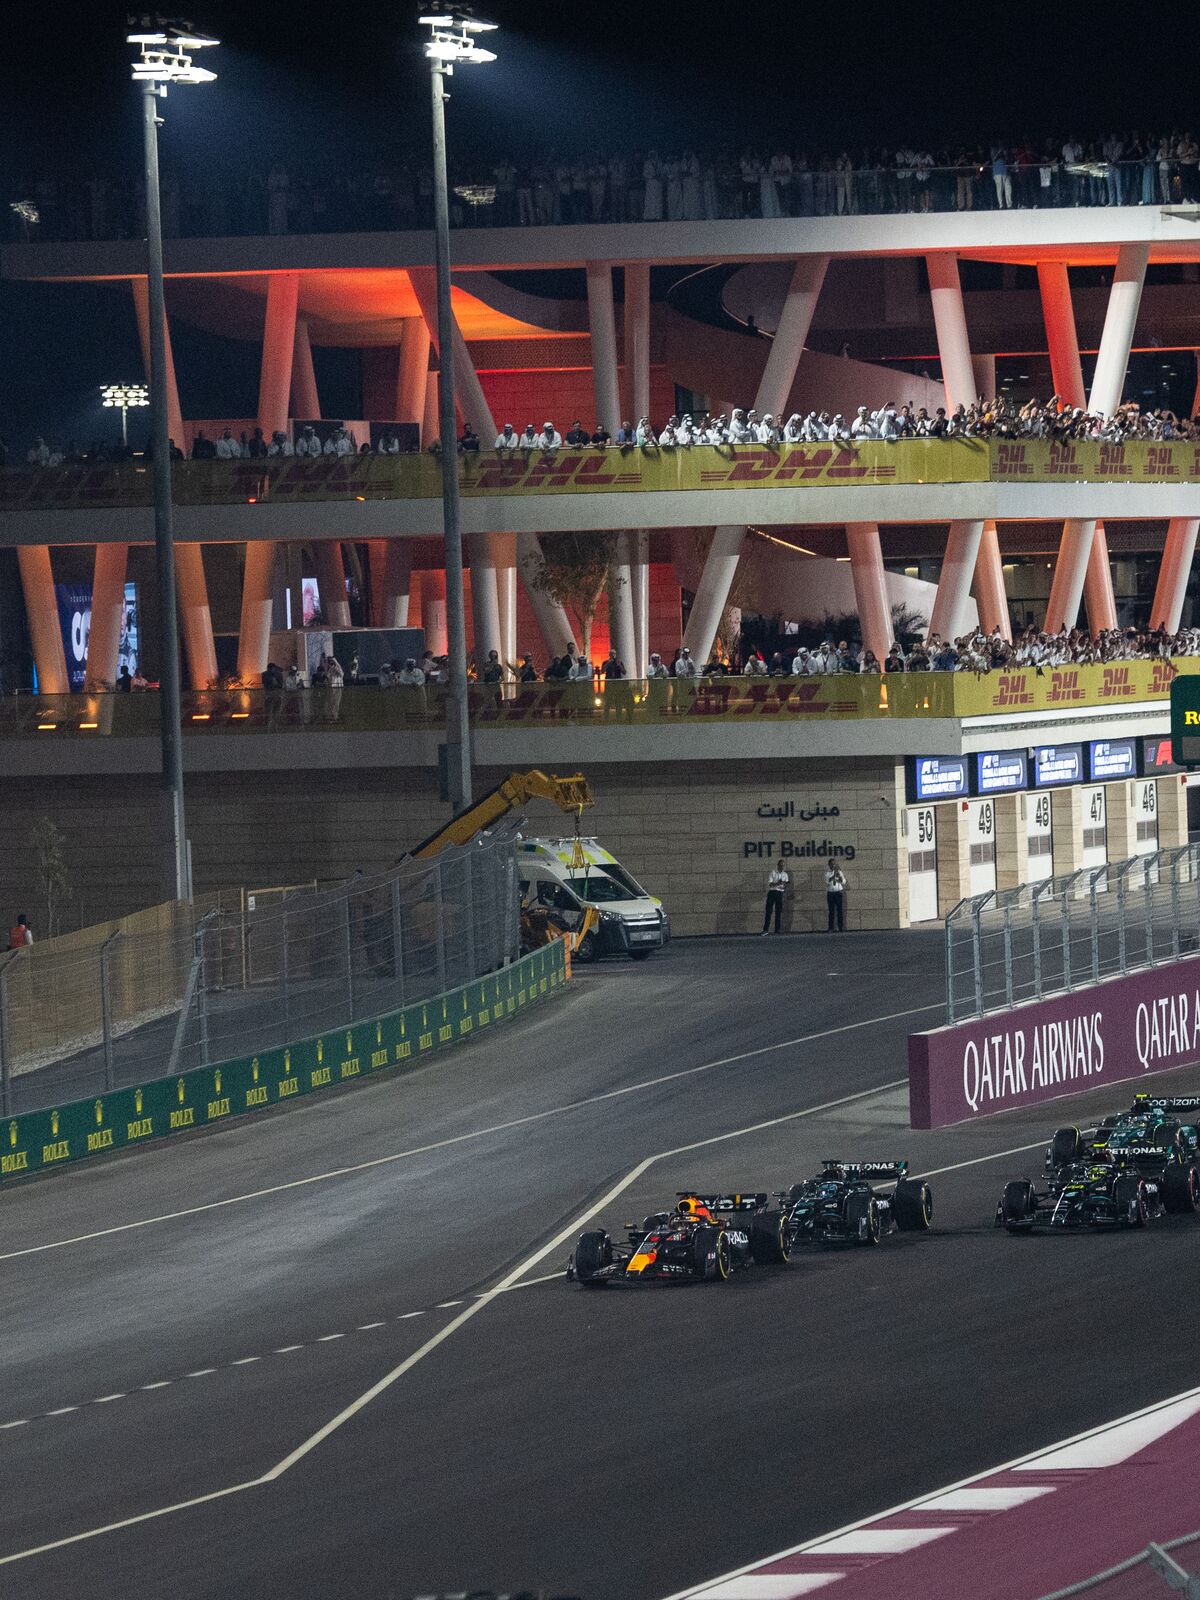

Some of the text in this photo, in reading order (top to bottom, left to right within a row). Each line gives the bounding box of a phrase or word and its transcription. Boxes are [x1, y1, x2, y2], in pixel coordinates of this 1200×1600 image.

[476, 456, 616, 488] DHL
[727, 448, 870, 480] DHL
[999, 445, 1028, 474] DHL
[1049, 446, 1078, 474] DHL
[998, 675, 1029, 704] DHL
[1051, 671, 1080, 700] DHL
[1103, 668, 1130, 696] DHL
[687, 685, 830, 716] DHL
[757, 801, 841, 822] مبنى البت
[1091, 793, 1102, 822] 47
[1142, 783, 1155, 812] 46
[979, 804, 992, 834] 49
[1036, 797, 1049, 827] 48
[918, 810, 933, 843] 50
[744, 840, 856, 861] PIT Building
[1136, 994, 1190, 1068] QATAR
[341, 1058, 360, 1078] ROLEX
[964, 1012, 1104, 1111] QATAR AIRWAYS
[279, 1077, 299, 1097] ROLEX
[311, 1067, 331, 1087] ROLEX
[208, 1098, 230, 1119] ROLEX
[246, 1086, 268, 1106] ROLEX
[127, 1118, 152, 1139] ROLEX
[170, 1108, 194, 1128] ROLEX
[43, 1141, 69, 1162] ROLEX
[88, 1129, 113, 1150] ROLEX
[1105, 1146, 1164, 1155] PETRONAS
[1, 1152, 28, 1173] ROLEX
[835, 1162, 895, 1171] PETRONAS
